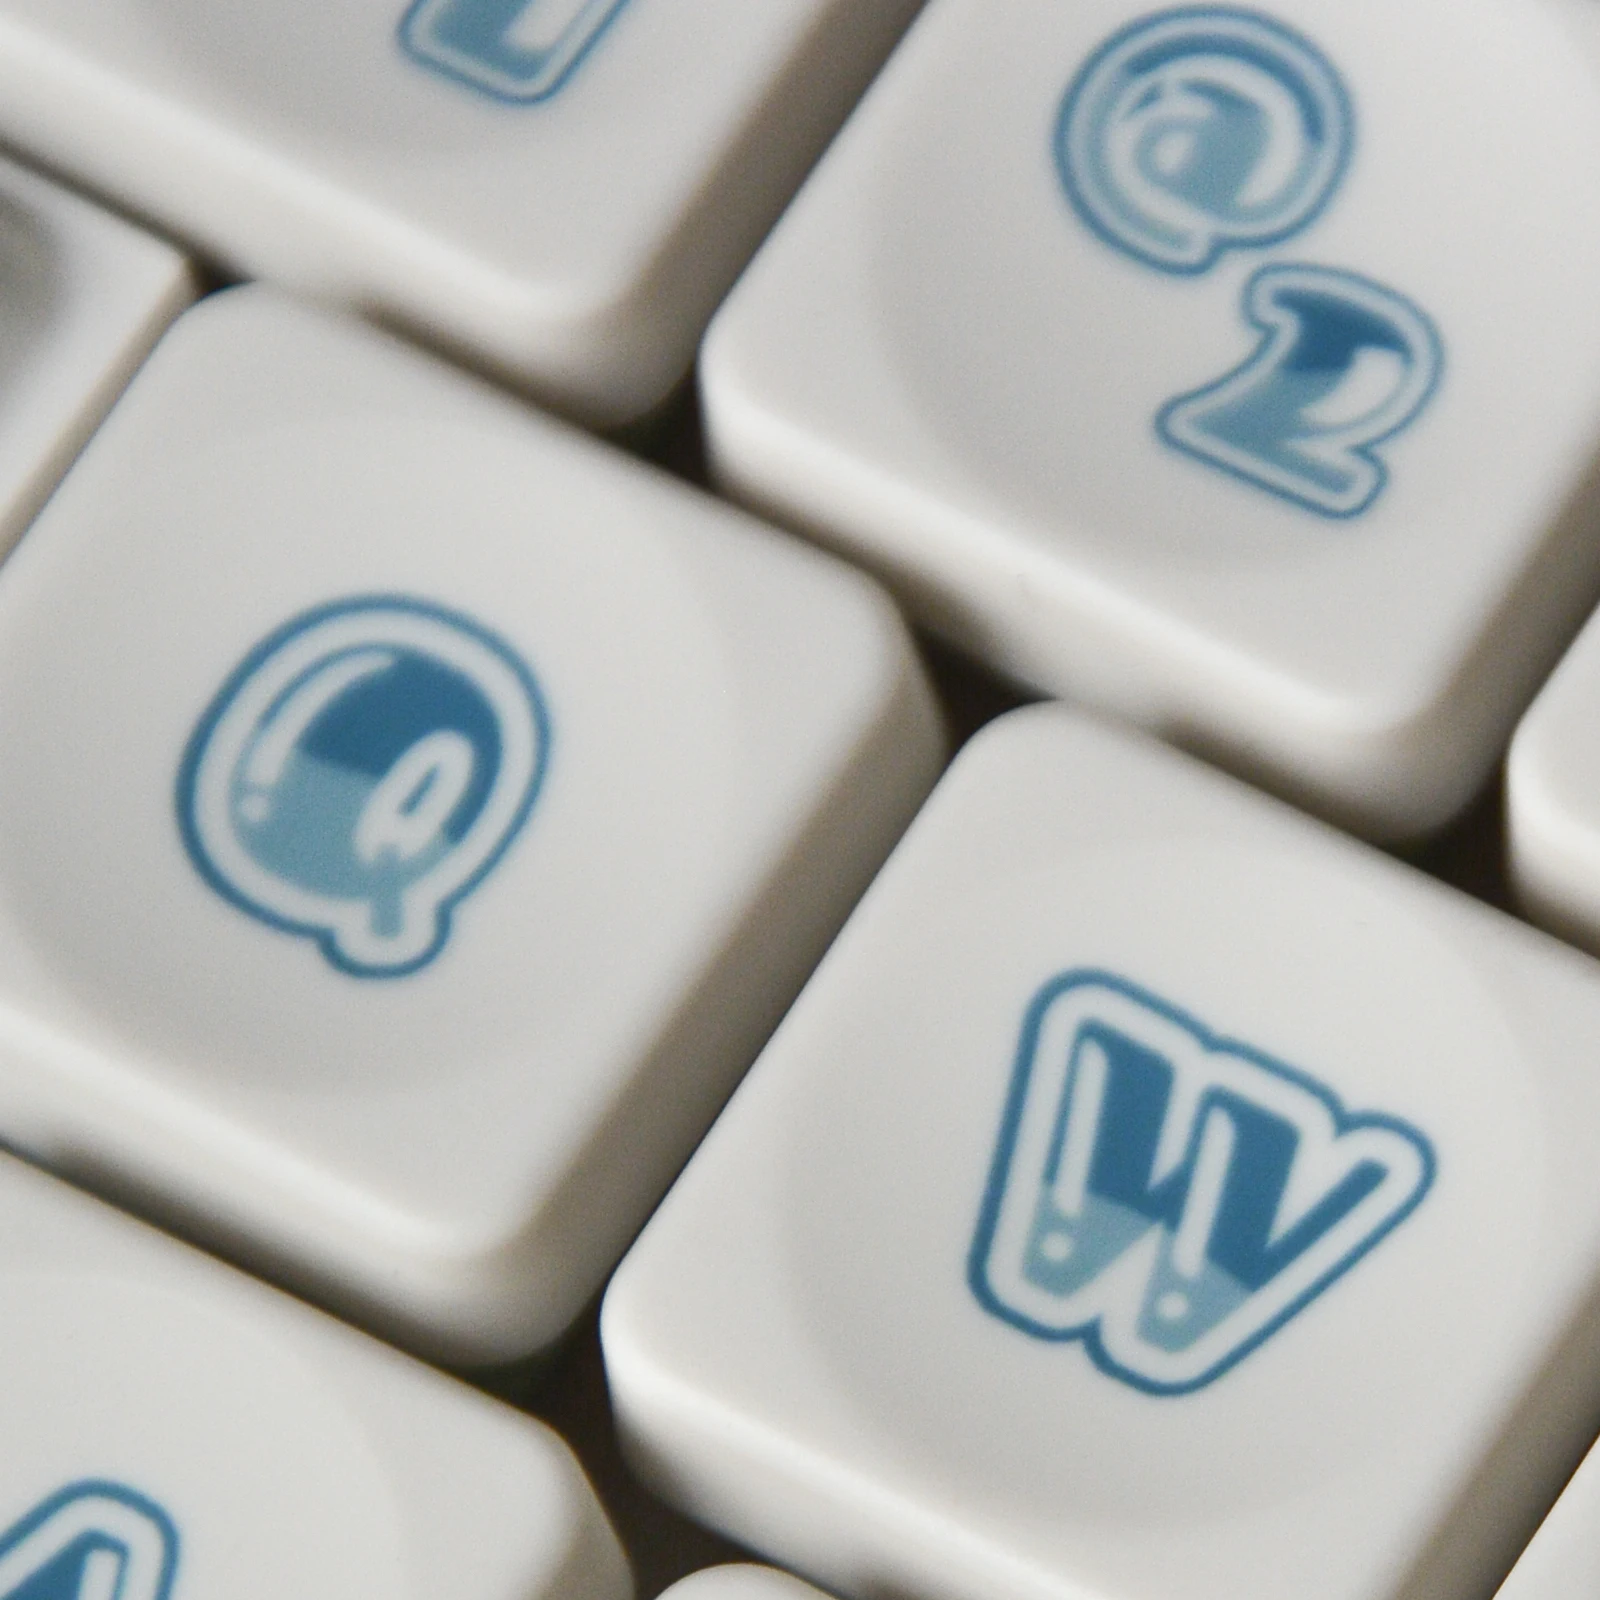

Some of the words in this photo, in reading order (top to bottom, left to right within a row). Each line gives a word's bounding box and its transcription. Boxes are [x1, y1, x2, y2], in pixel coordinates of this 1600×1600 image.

[1154, 263, 1444, 519] 2
[174, 594, 552, 982] Q
[966, 967, 1439, 1400] W
